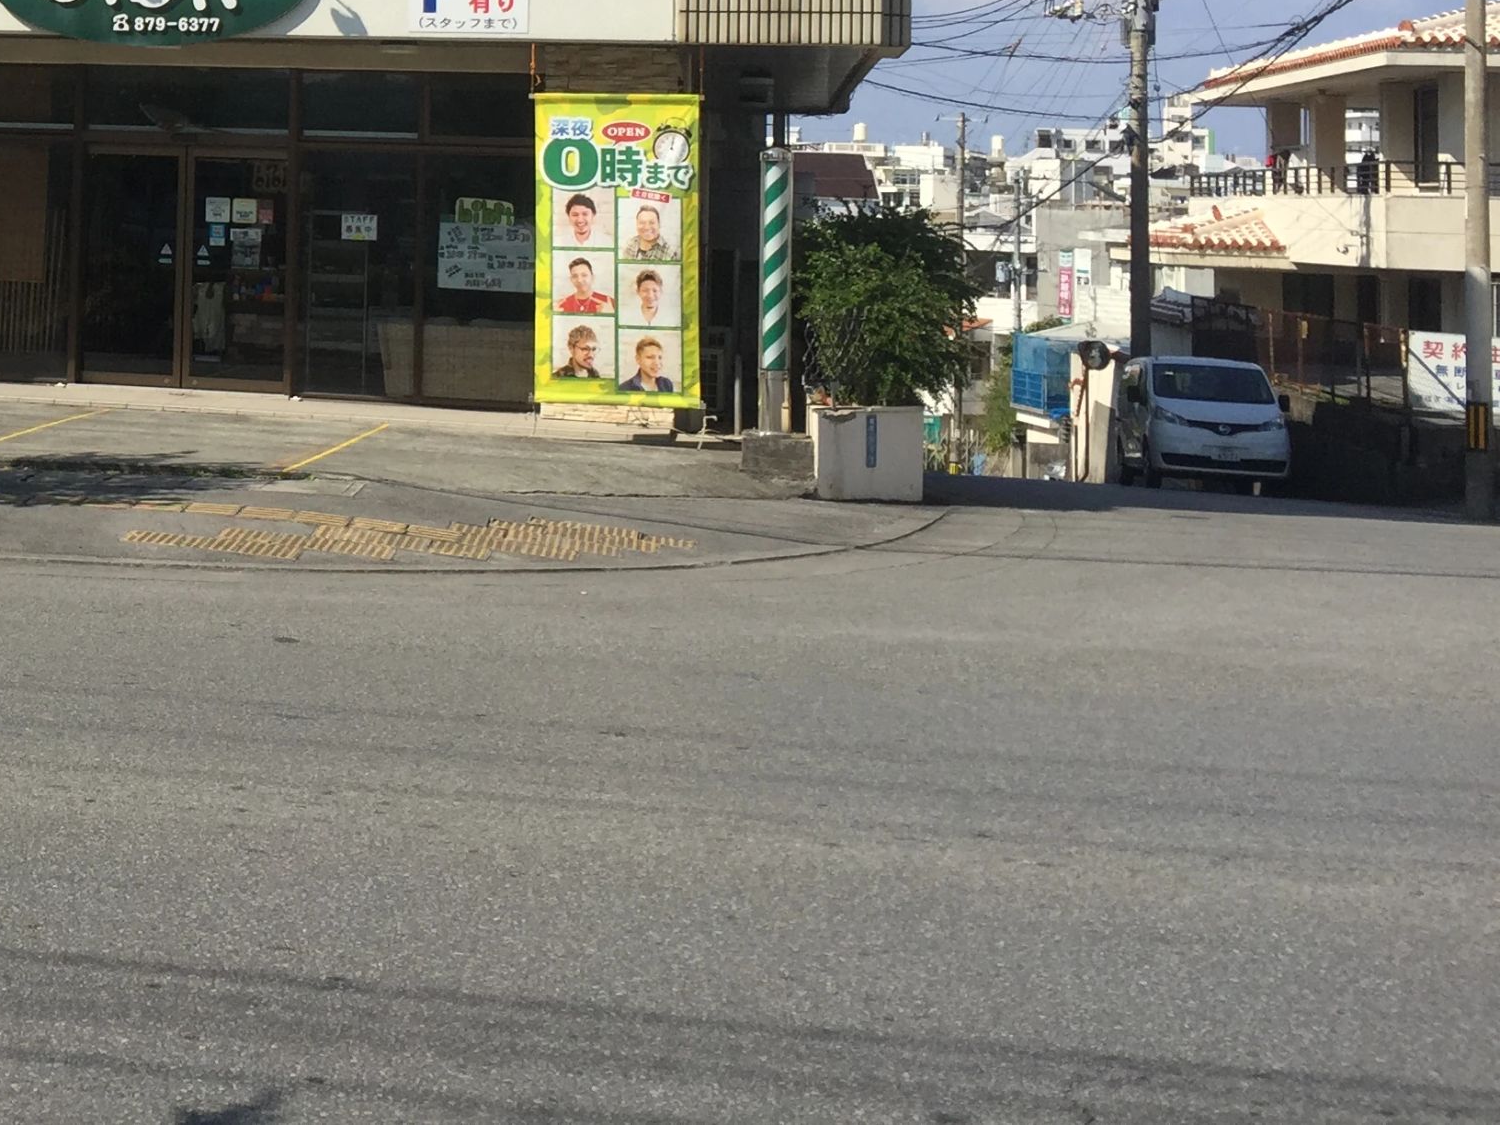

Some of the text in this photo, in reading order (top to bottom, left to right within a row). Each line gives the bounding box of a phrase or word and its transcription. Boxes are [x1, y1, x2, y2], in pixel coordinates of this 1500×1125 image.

[134, 16, 220, 32] 879-6377
[550, 118, 591, 137] 深夜
[606, 127, 646, 137] OPEN
[542, 137, 691, 187] 0時まで
